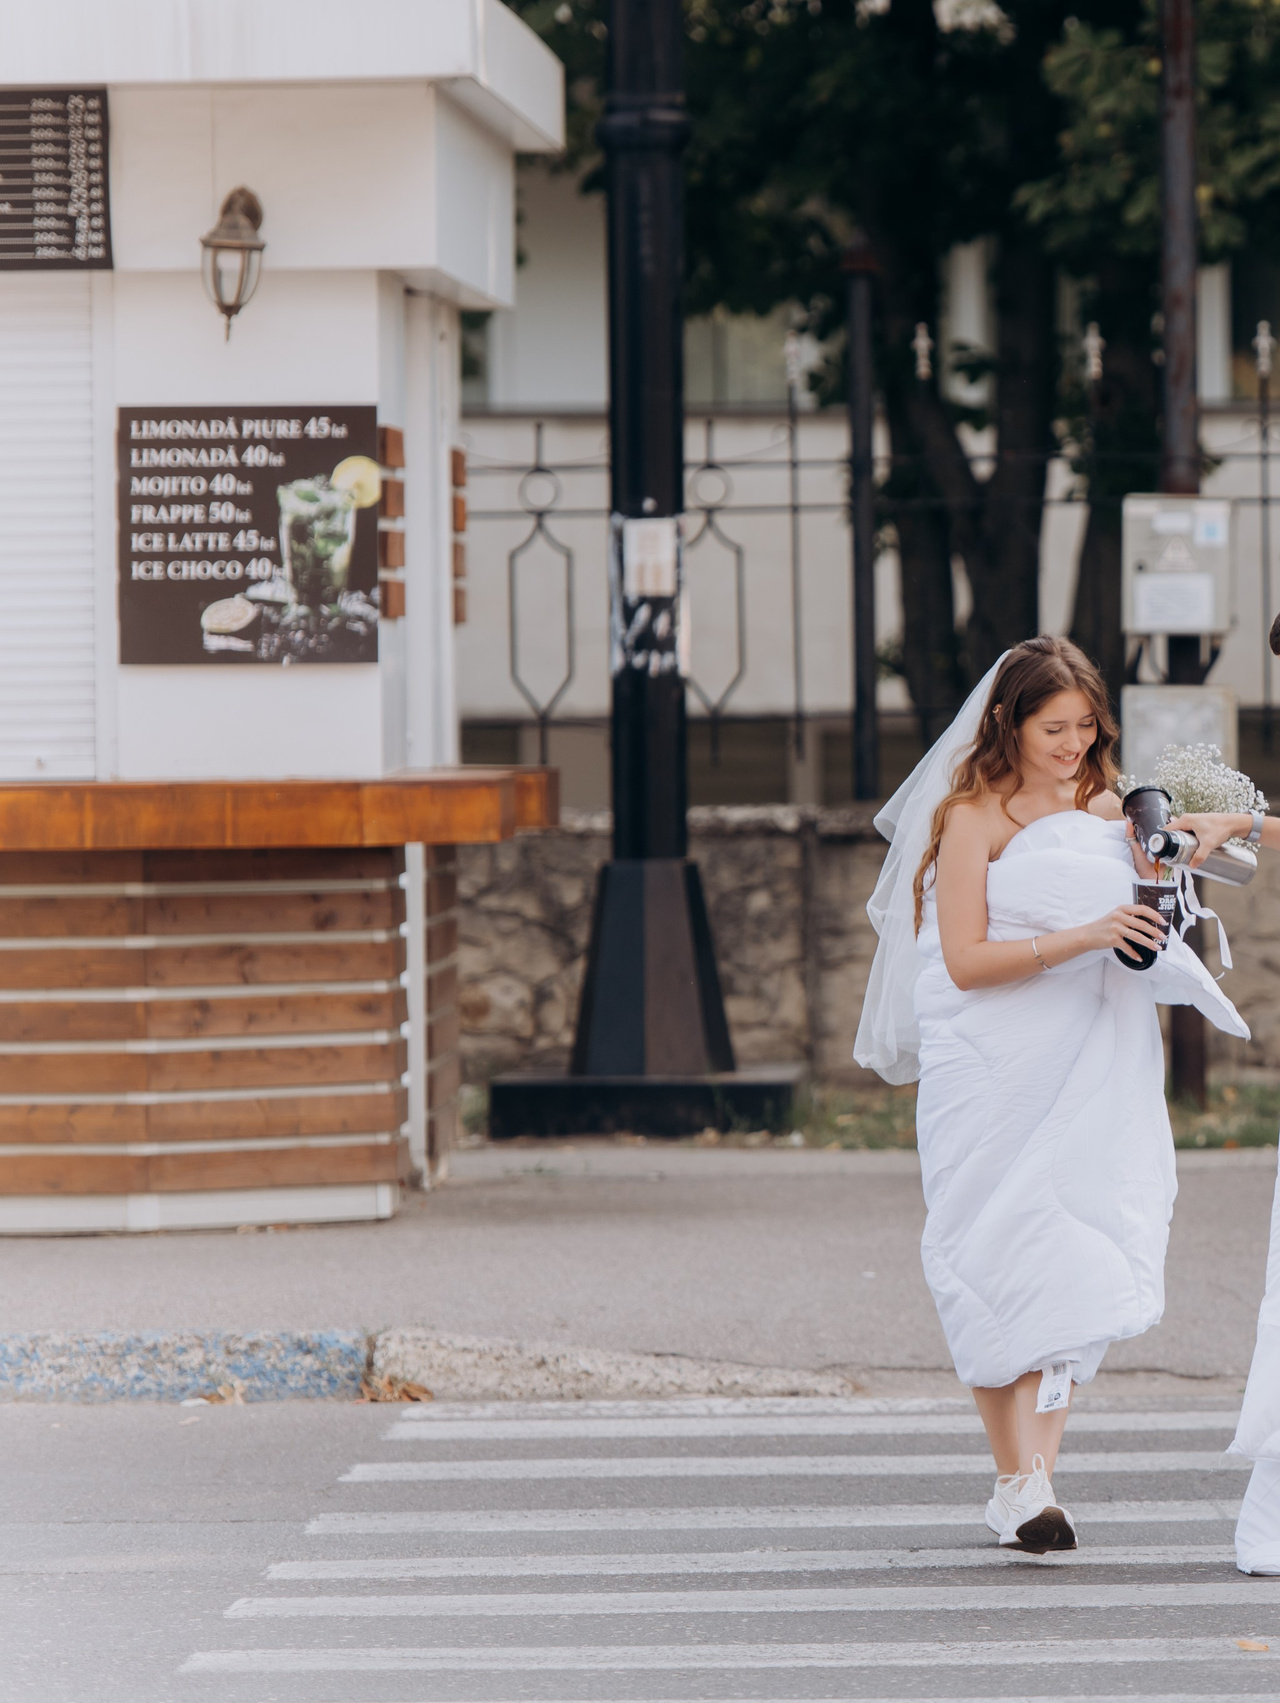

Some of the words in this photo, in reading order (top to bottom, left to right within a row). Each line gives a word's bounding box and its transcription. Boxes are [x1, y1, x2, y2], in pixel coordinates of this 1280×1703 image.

[241, 418, 303, 440] PIURE
[130, 475, 208, 498] MOJITO
[130, 504, 207, 524] FRAPPE
[130, 532, 166, 552] ICE
[167, 532, 232, 553] LATTE
[130, 560, 166, 581] ICE
[166, 559, 244, 581] CHOCO
